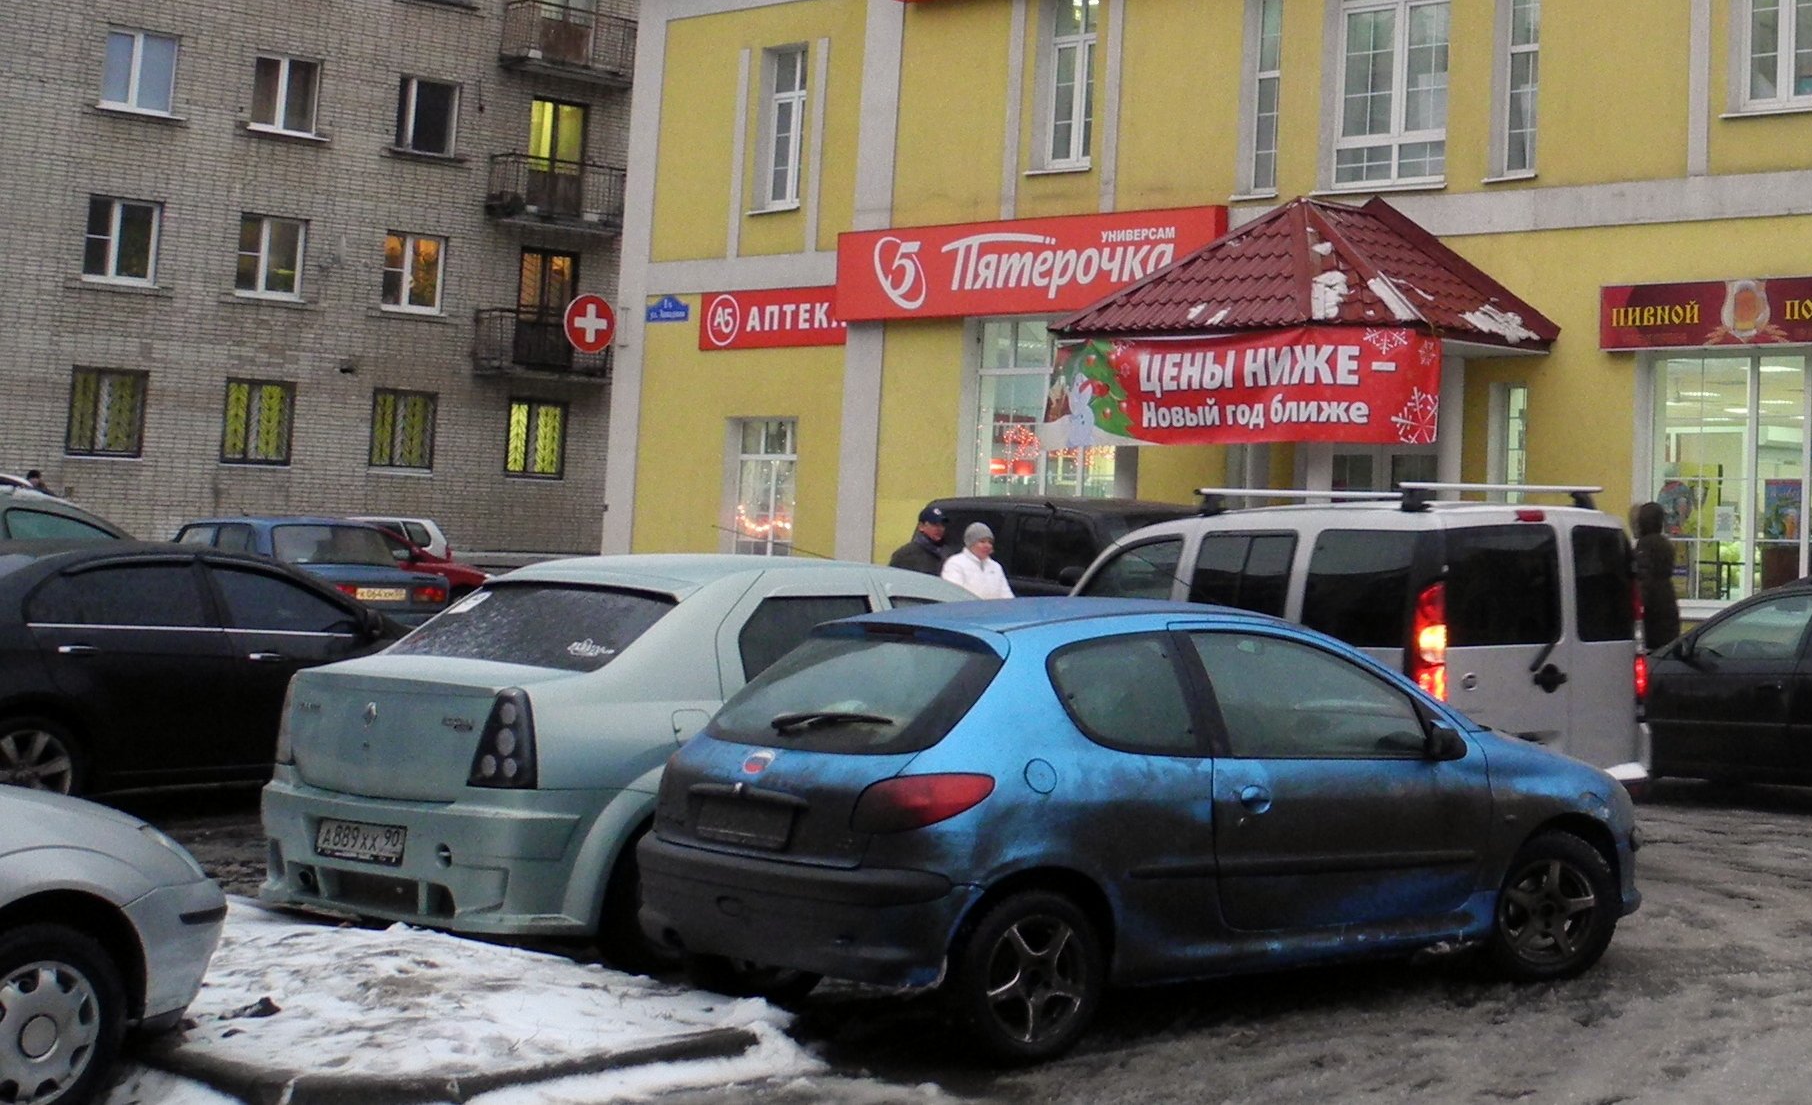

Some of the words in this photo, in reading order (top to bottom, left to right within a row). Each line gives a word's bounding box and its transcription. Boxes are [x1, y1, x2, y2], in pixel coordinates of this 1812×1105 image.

[1100, 226, 1176, 243] УНИВЕРСАМ
[941, 231, 1175, 299] Пятёрочка
[746, 302, 847, 332] АПТЕК
[1611, 300, 1700, 327] ПИВНОЙ
[1139, 346, 1234, 398] ЦЕНЫ
[1243, 344, 1361, 387] НИЖЕ
[1141, 396, 1220, 429] Новый
[1227, 404, 1265, 430] год
[1271, 393, 1369, 425] ближе
